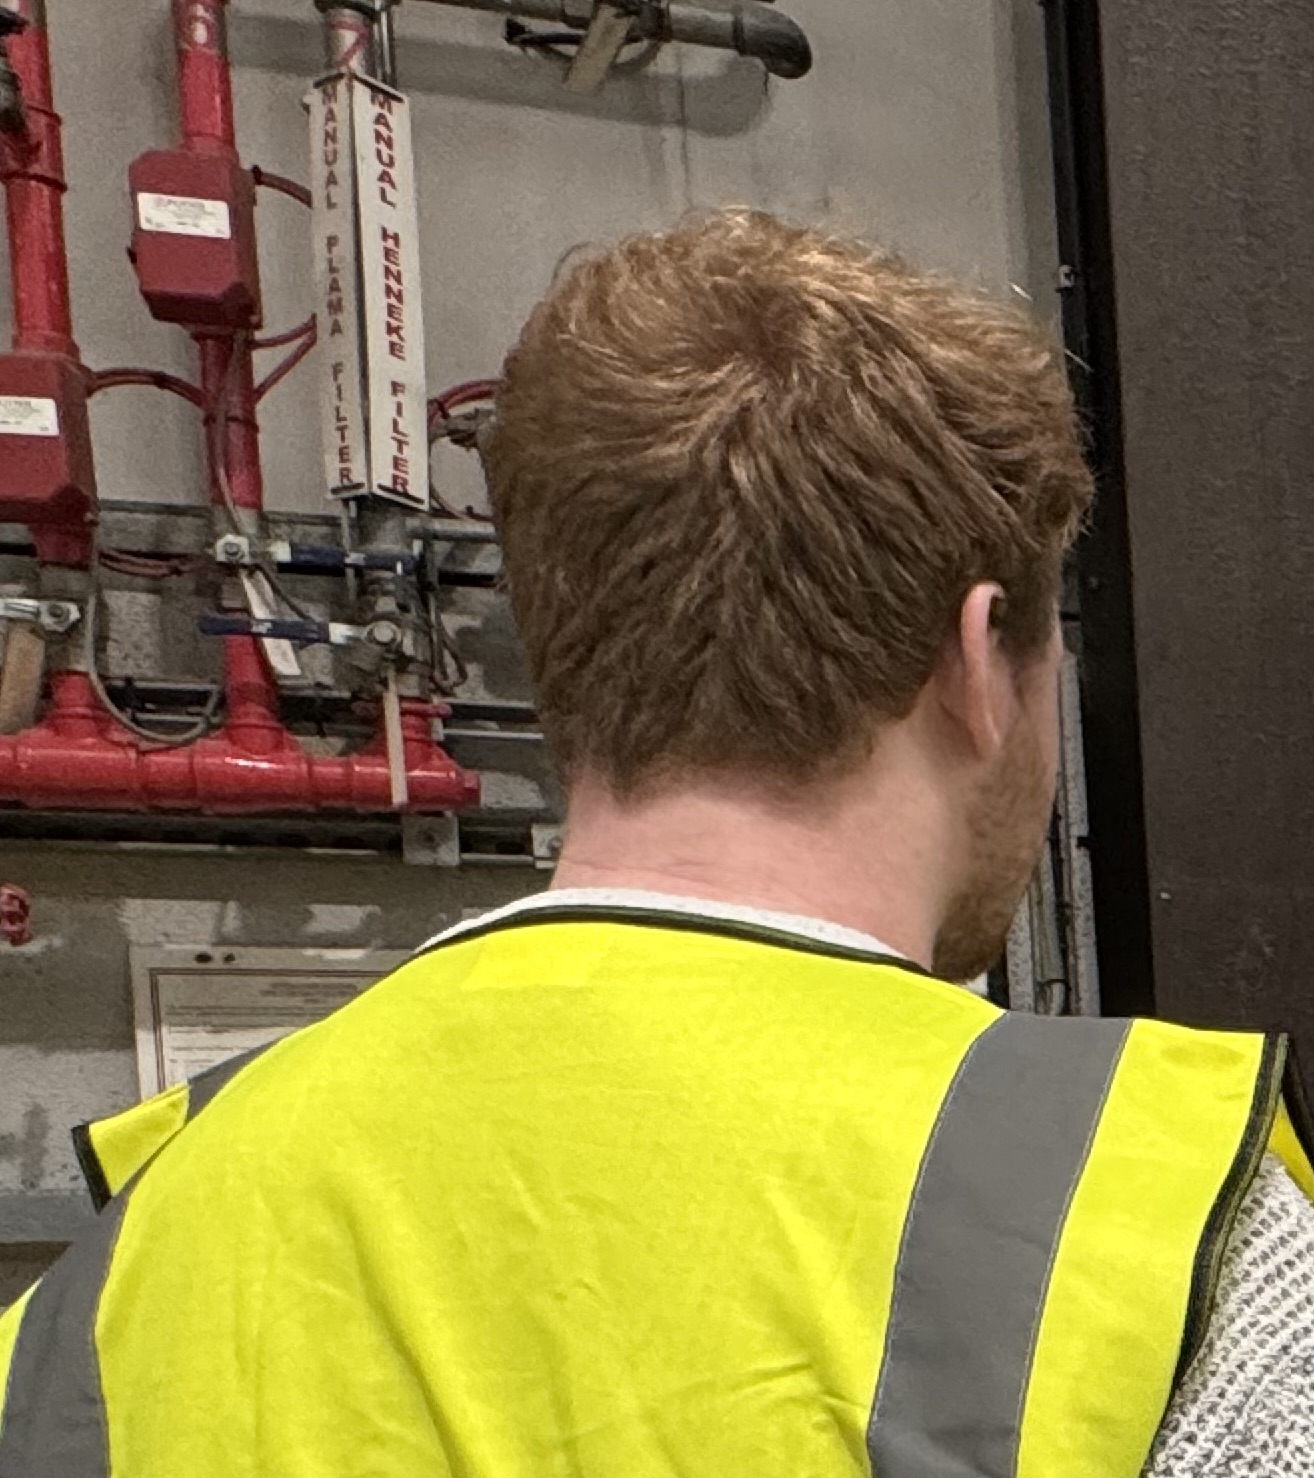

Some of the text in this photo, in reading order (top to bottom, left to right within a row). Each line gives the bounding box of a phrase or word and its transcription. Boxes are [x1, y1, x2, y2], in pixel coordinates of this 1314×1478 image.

[323, 83, 338, 209] MANUAL
[331, 361, 354, 485] FILTER
[371, 90, 410, 494] MANUAL HENNEKE FILTER
